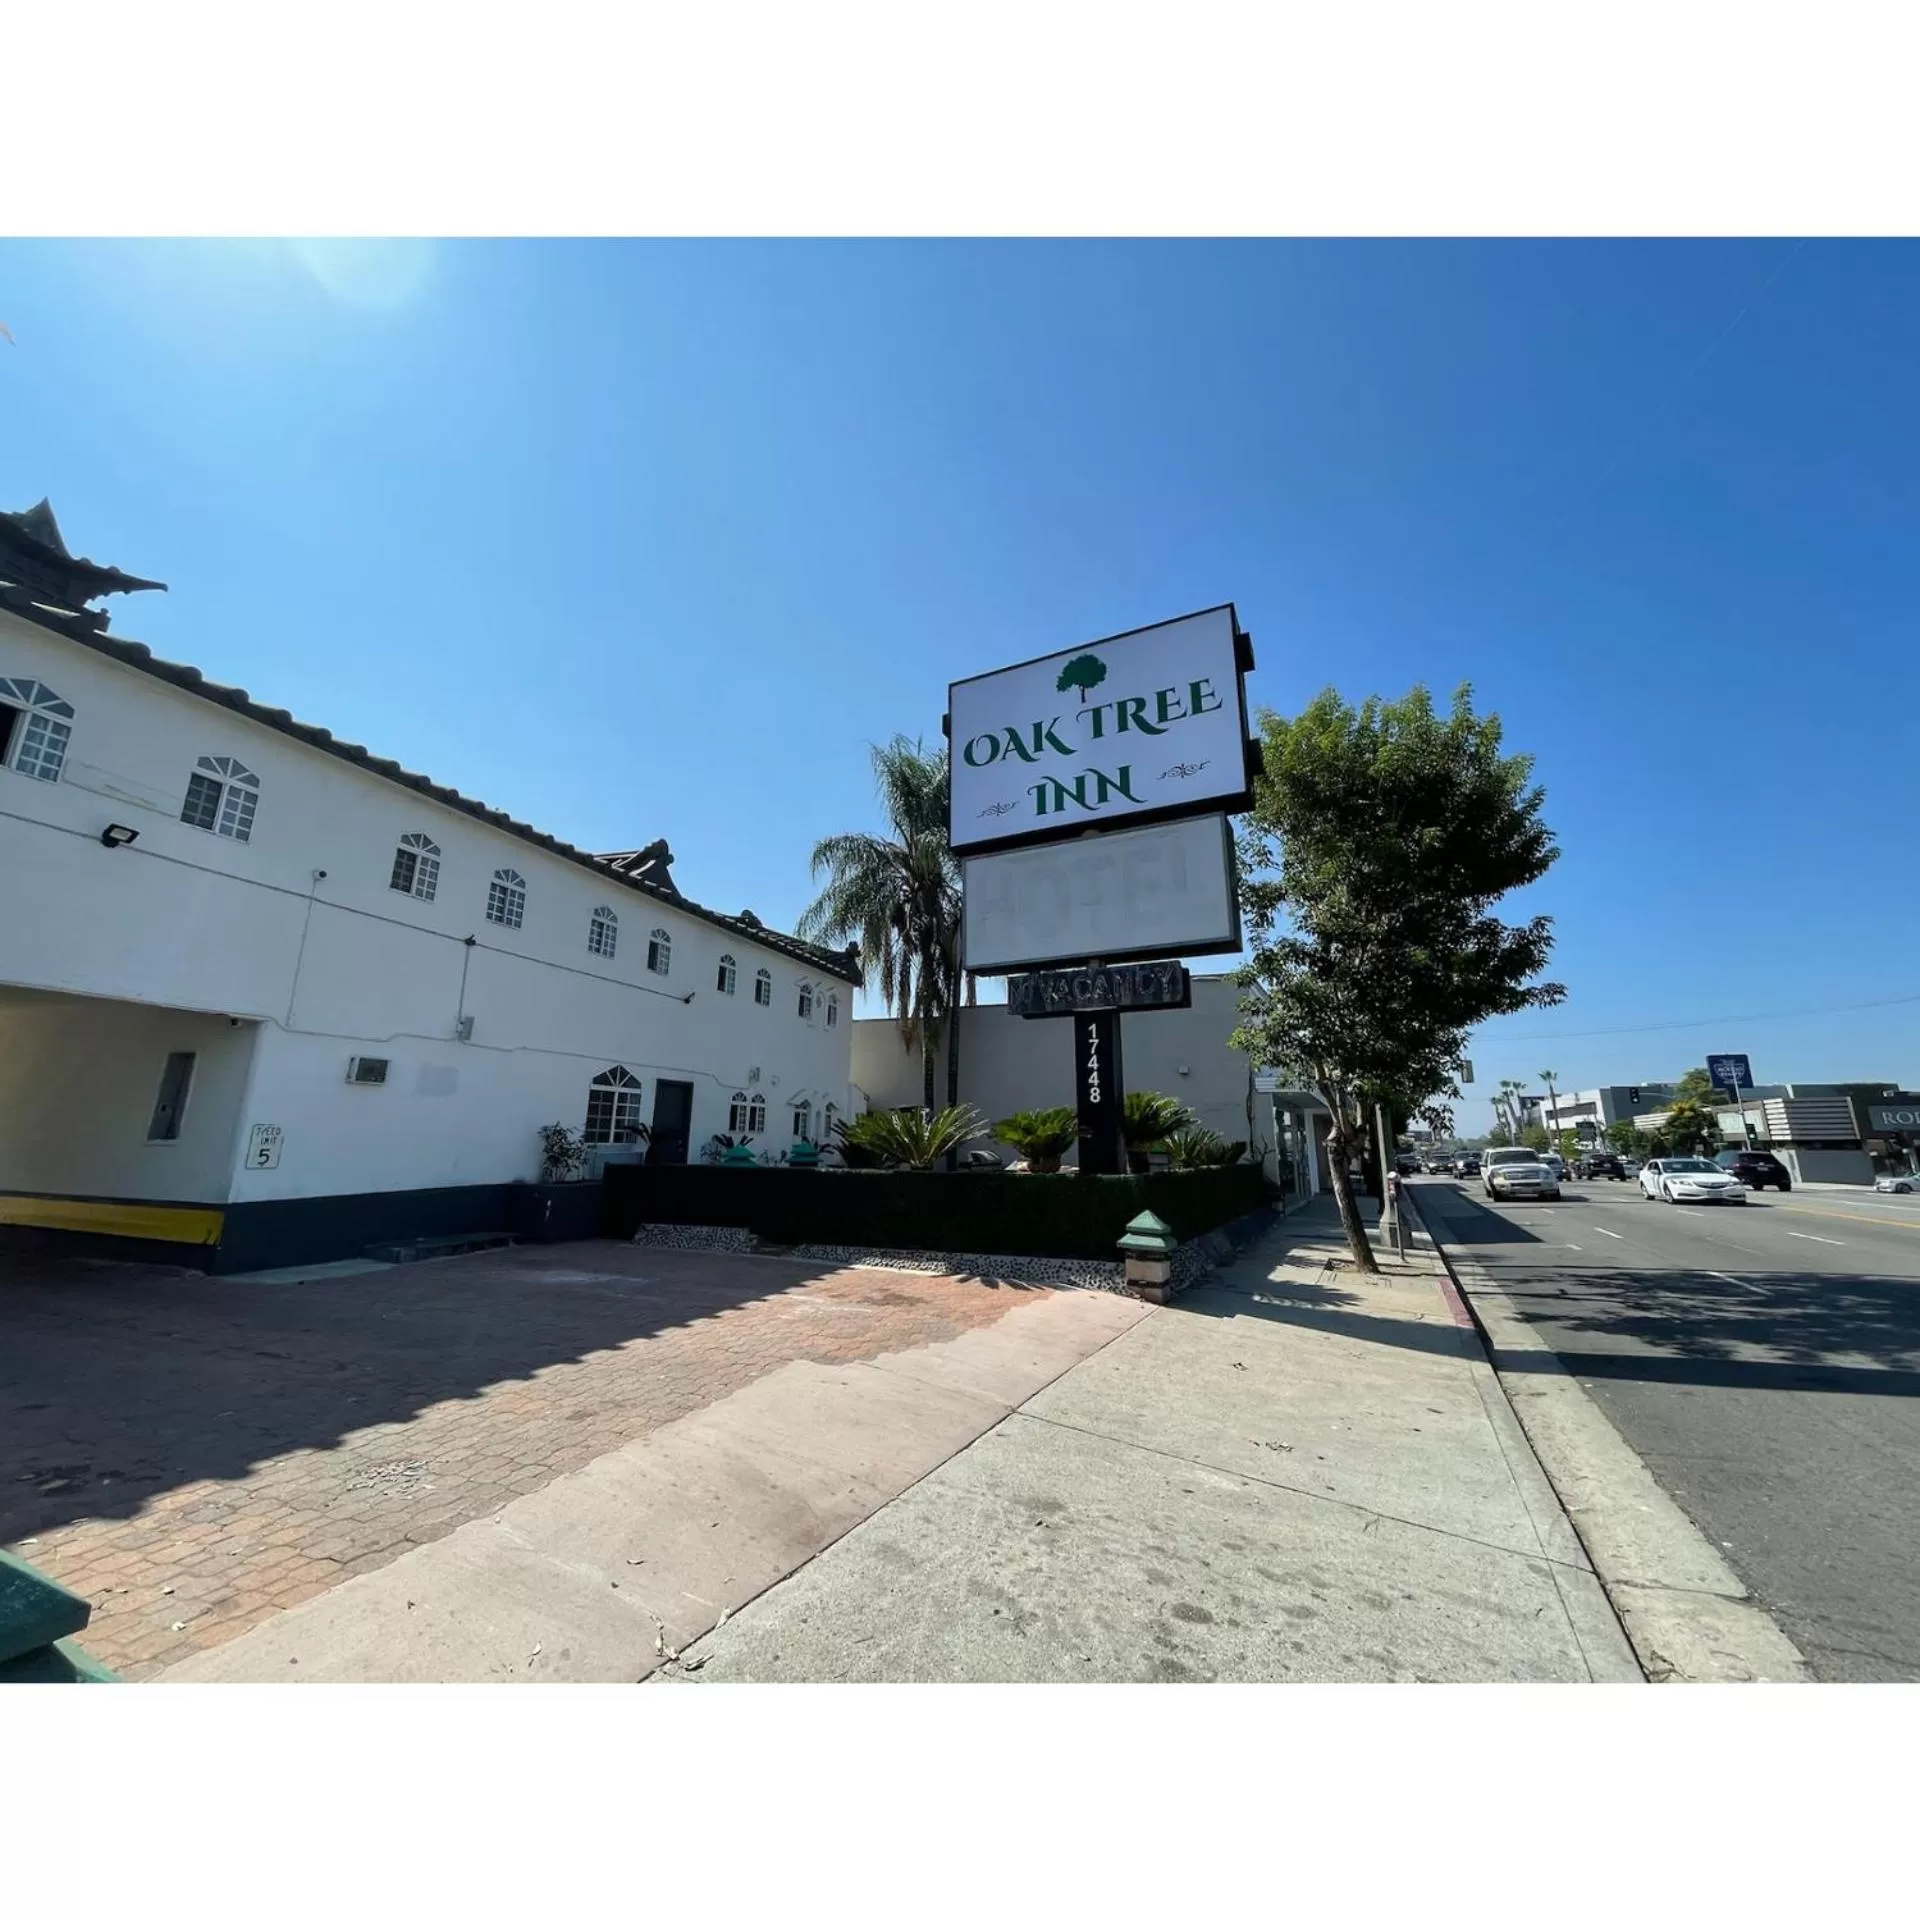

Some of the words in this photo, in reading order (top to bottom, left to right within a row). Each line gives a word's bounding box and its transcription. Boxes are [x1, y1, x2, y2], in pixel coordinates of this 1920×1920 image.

[964, 716, 1078, 767] OAK
[1076, 678, 1223, 740] TREE
[1027, 765, 1148, 815] INN
[1039, 968, 1174, 1004] VACANCY
[1087, 1023, 1101, 1103] 17448
[257, 1148, 270, 1166] 5
